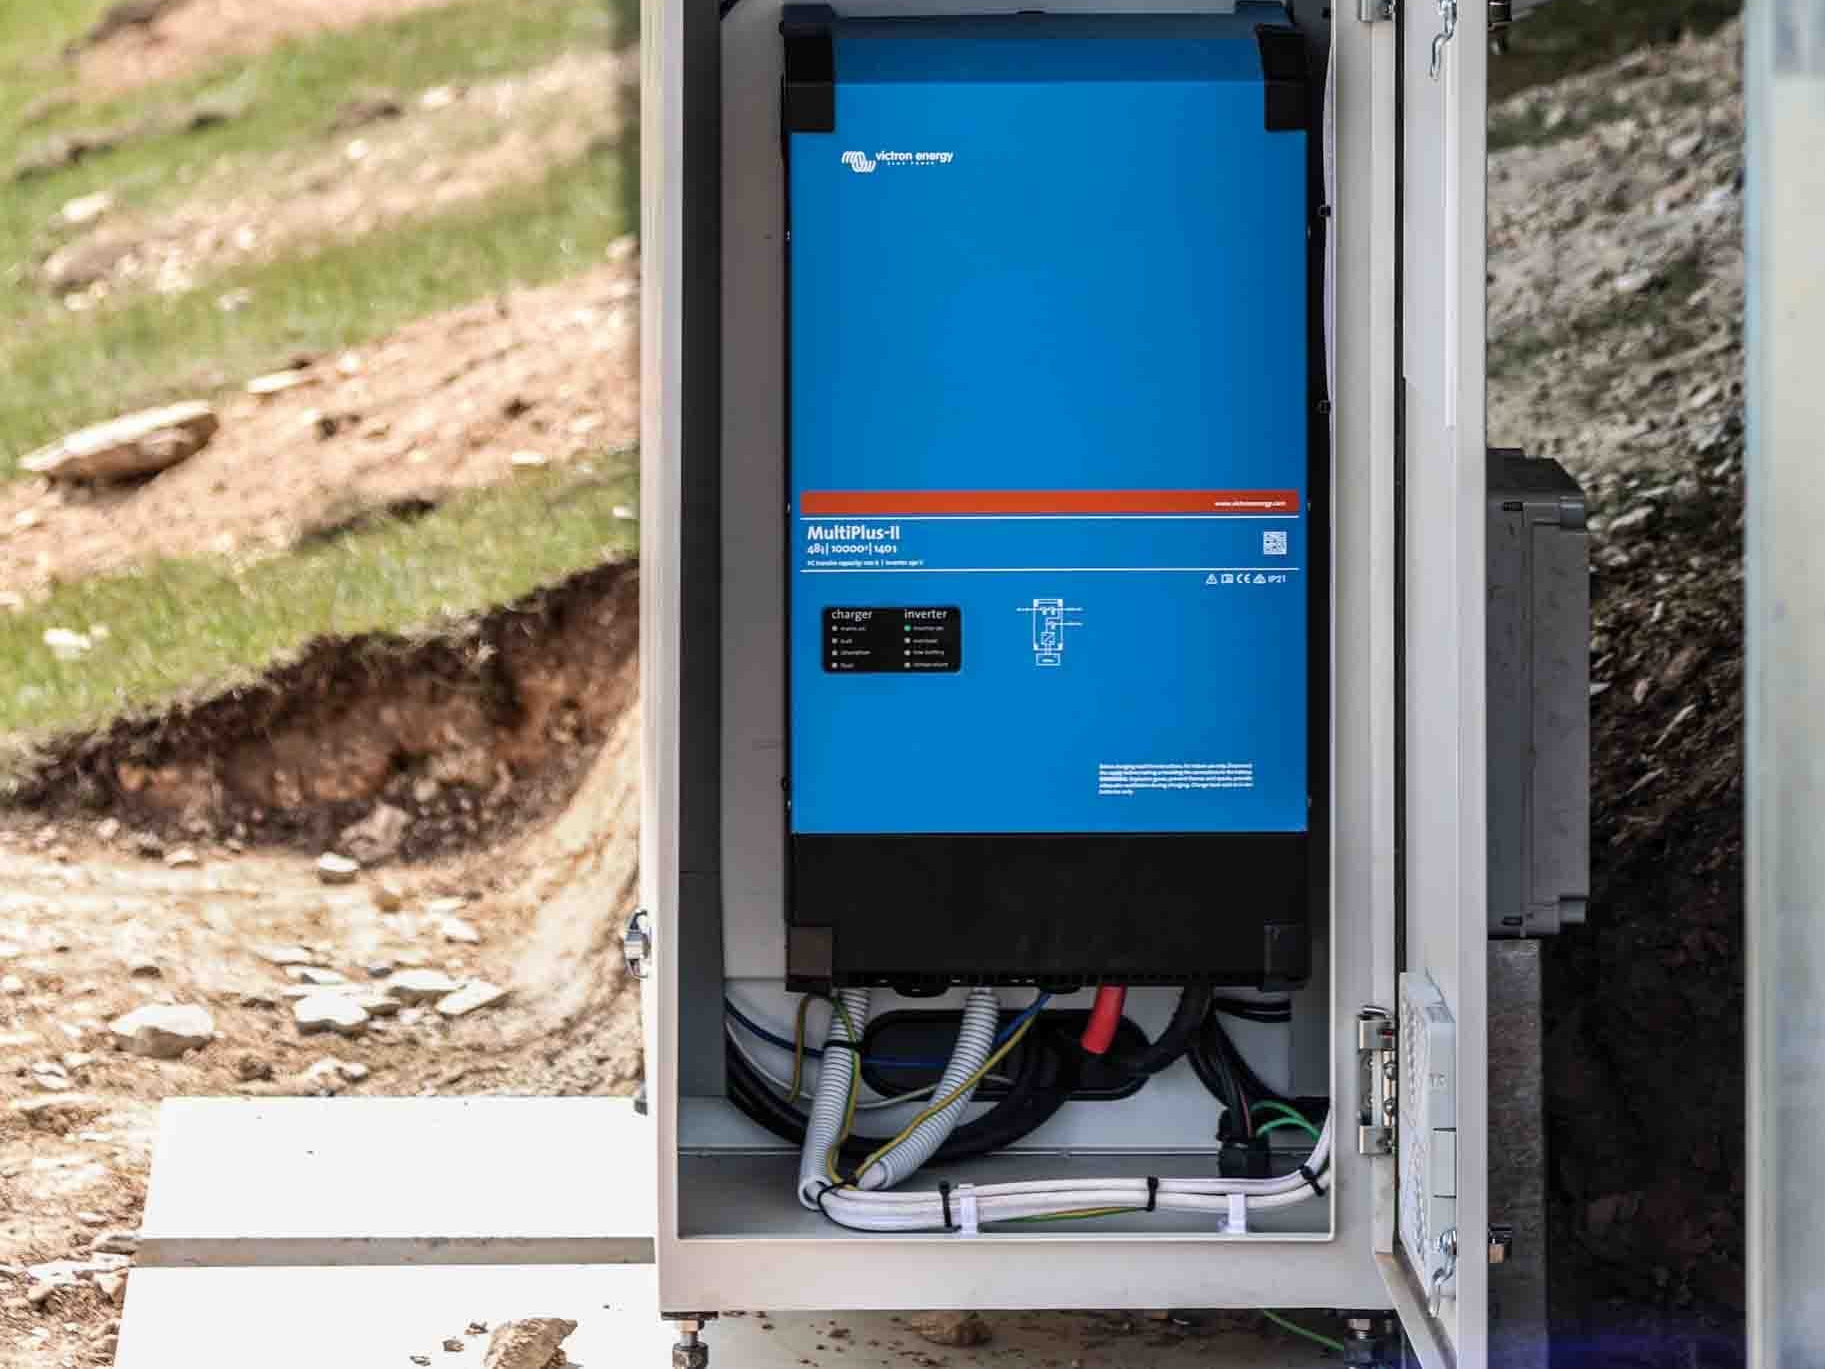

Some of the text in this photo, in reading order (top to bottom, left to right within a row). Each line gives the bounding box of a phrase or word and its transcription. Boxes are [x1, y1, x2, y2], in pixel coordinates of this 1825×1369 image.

[875, 150, 954, 163] victron energy
[807, 524, 900, 541] MultiPlus-II
[831, 608, 872, 622] charger
[904, 608, 947, 620] inverter
